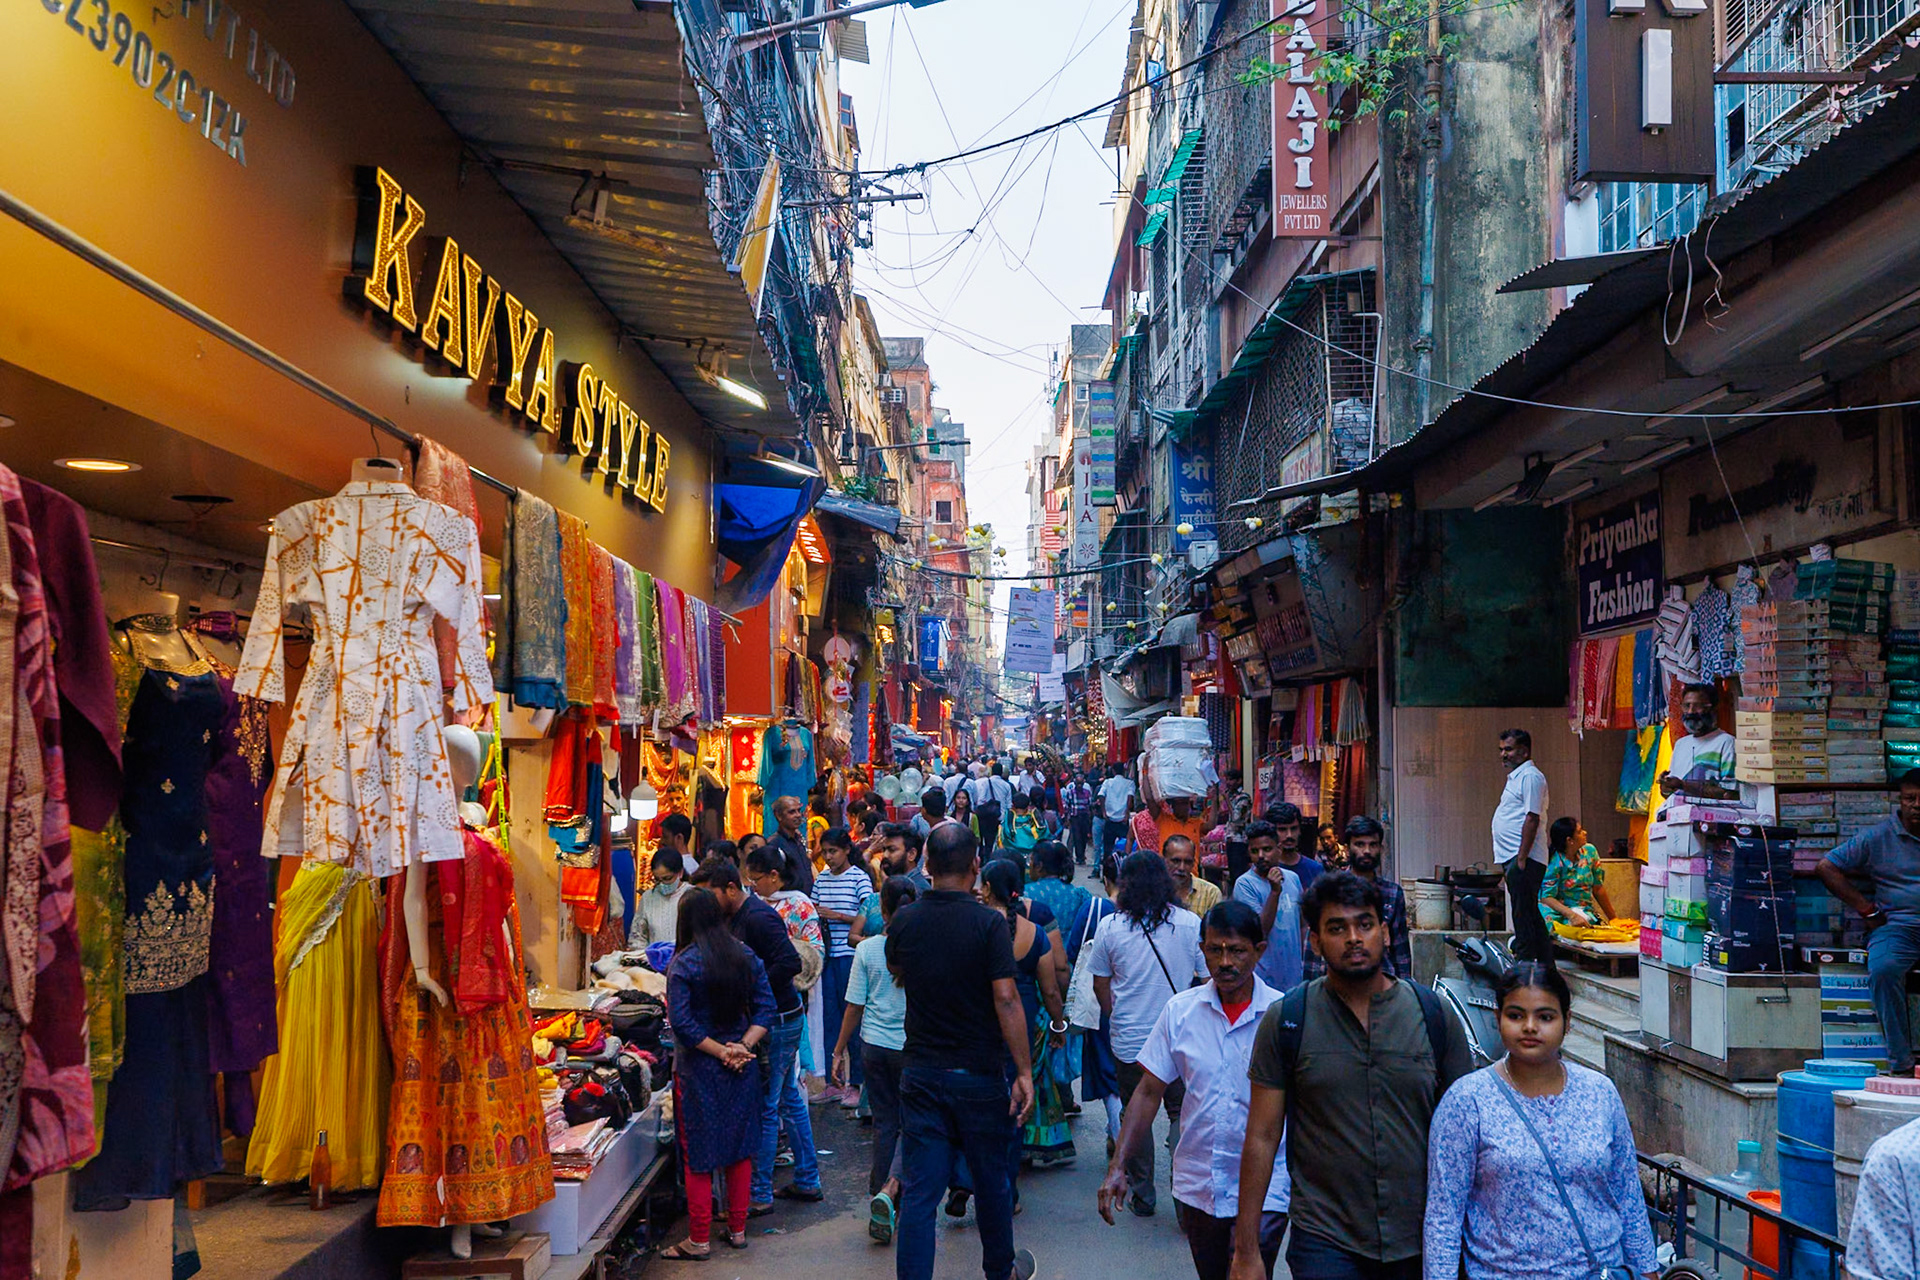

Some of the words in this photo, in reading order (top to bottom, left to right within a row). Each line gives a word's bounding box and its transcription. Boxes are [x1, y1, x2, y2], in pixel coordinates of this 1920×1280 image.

[247, 28, 296, 109] LTD
[1278, 194, 1328, 213] JEWELLERS
[1283, 214, 1303, 230] PVT
[1303, 214, 1321, 230] LTD
[363, 165, 556, 435] KAVYA
[571, 362, 671, 515] STYLE
[1181, 454, 1212, 482] श्री
[1579, 501, 1658, 570] Priyanka
[1587, 571, 1655, 626] Fashion
